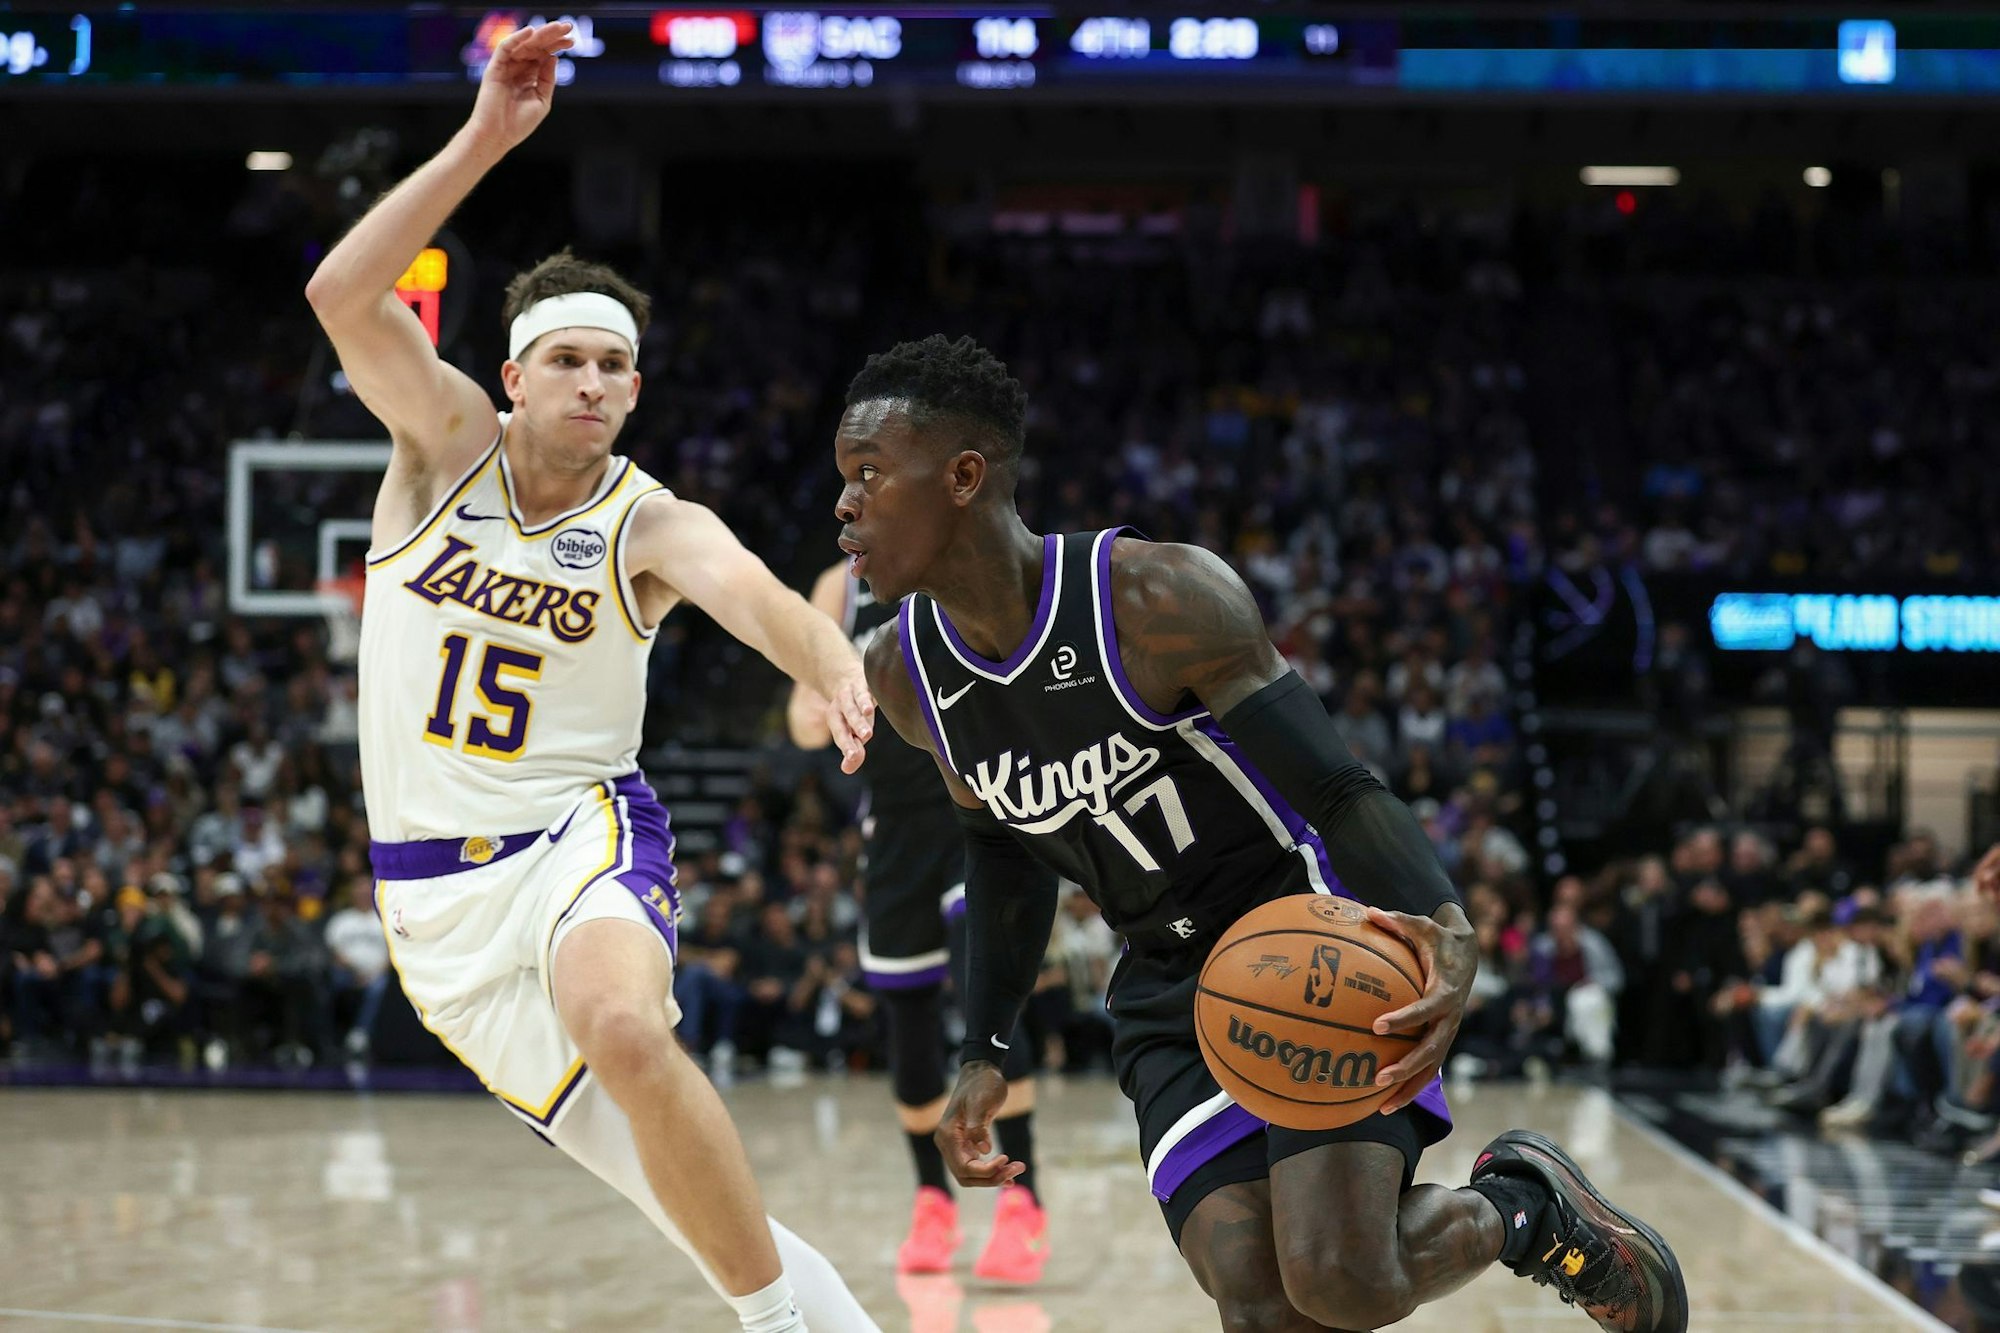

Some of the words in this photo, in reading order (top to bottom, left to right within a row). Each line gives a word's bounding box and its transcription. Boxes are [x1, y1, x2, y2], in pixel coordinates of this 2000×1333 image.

[819, 17, 901, 58] SAC
[1070, 17, 1151, 59] 4TH
[403, 534, 602, 644] LAKERS
[557, 539, 602, 558] bibigo
[423, 631, 546, 764] 15
[1044, 680, 1077, 692] PHOONG
[1077, 676, 1095, 685] LAW
[965, 732, 1160, 834] Kings
[1093, 775, 1196, 871] 17
[1227, 1014, 1377, 1088] Wilson
